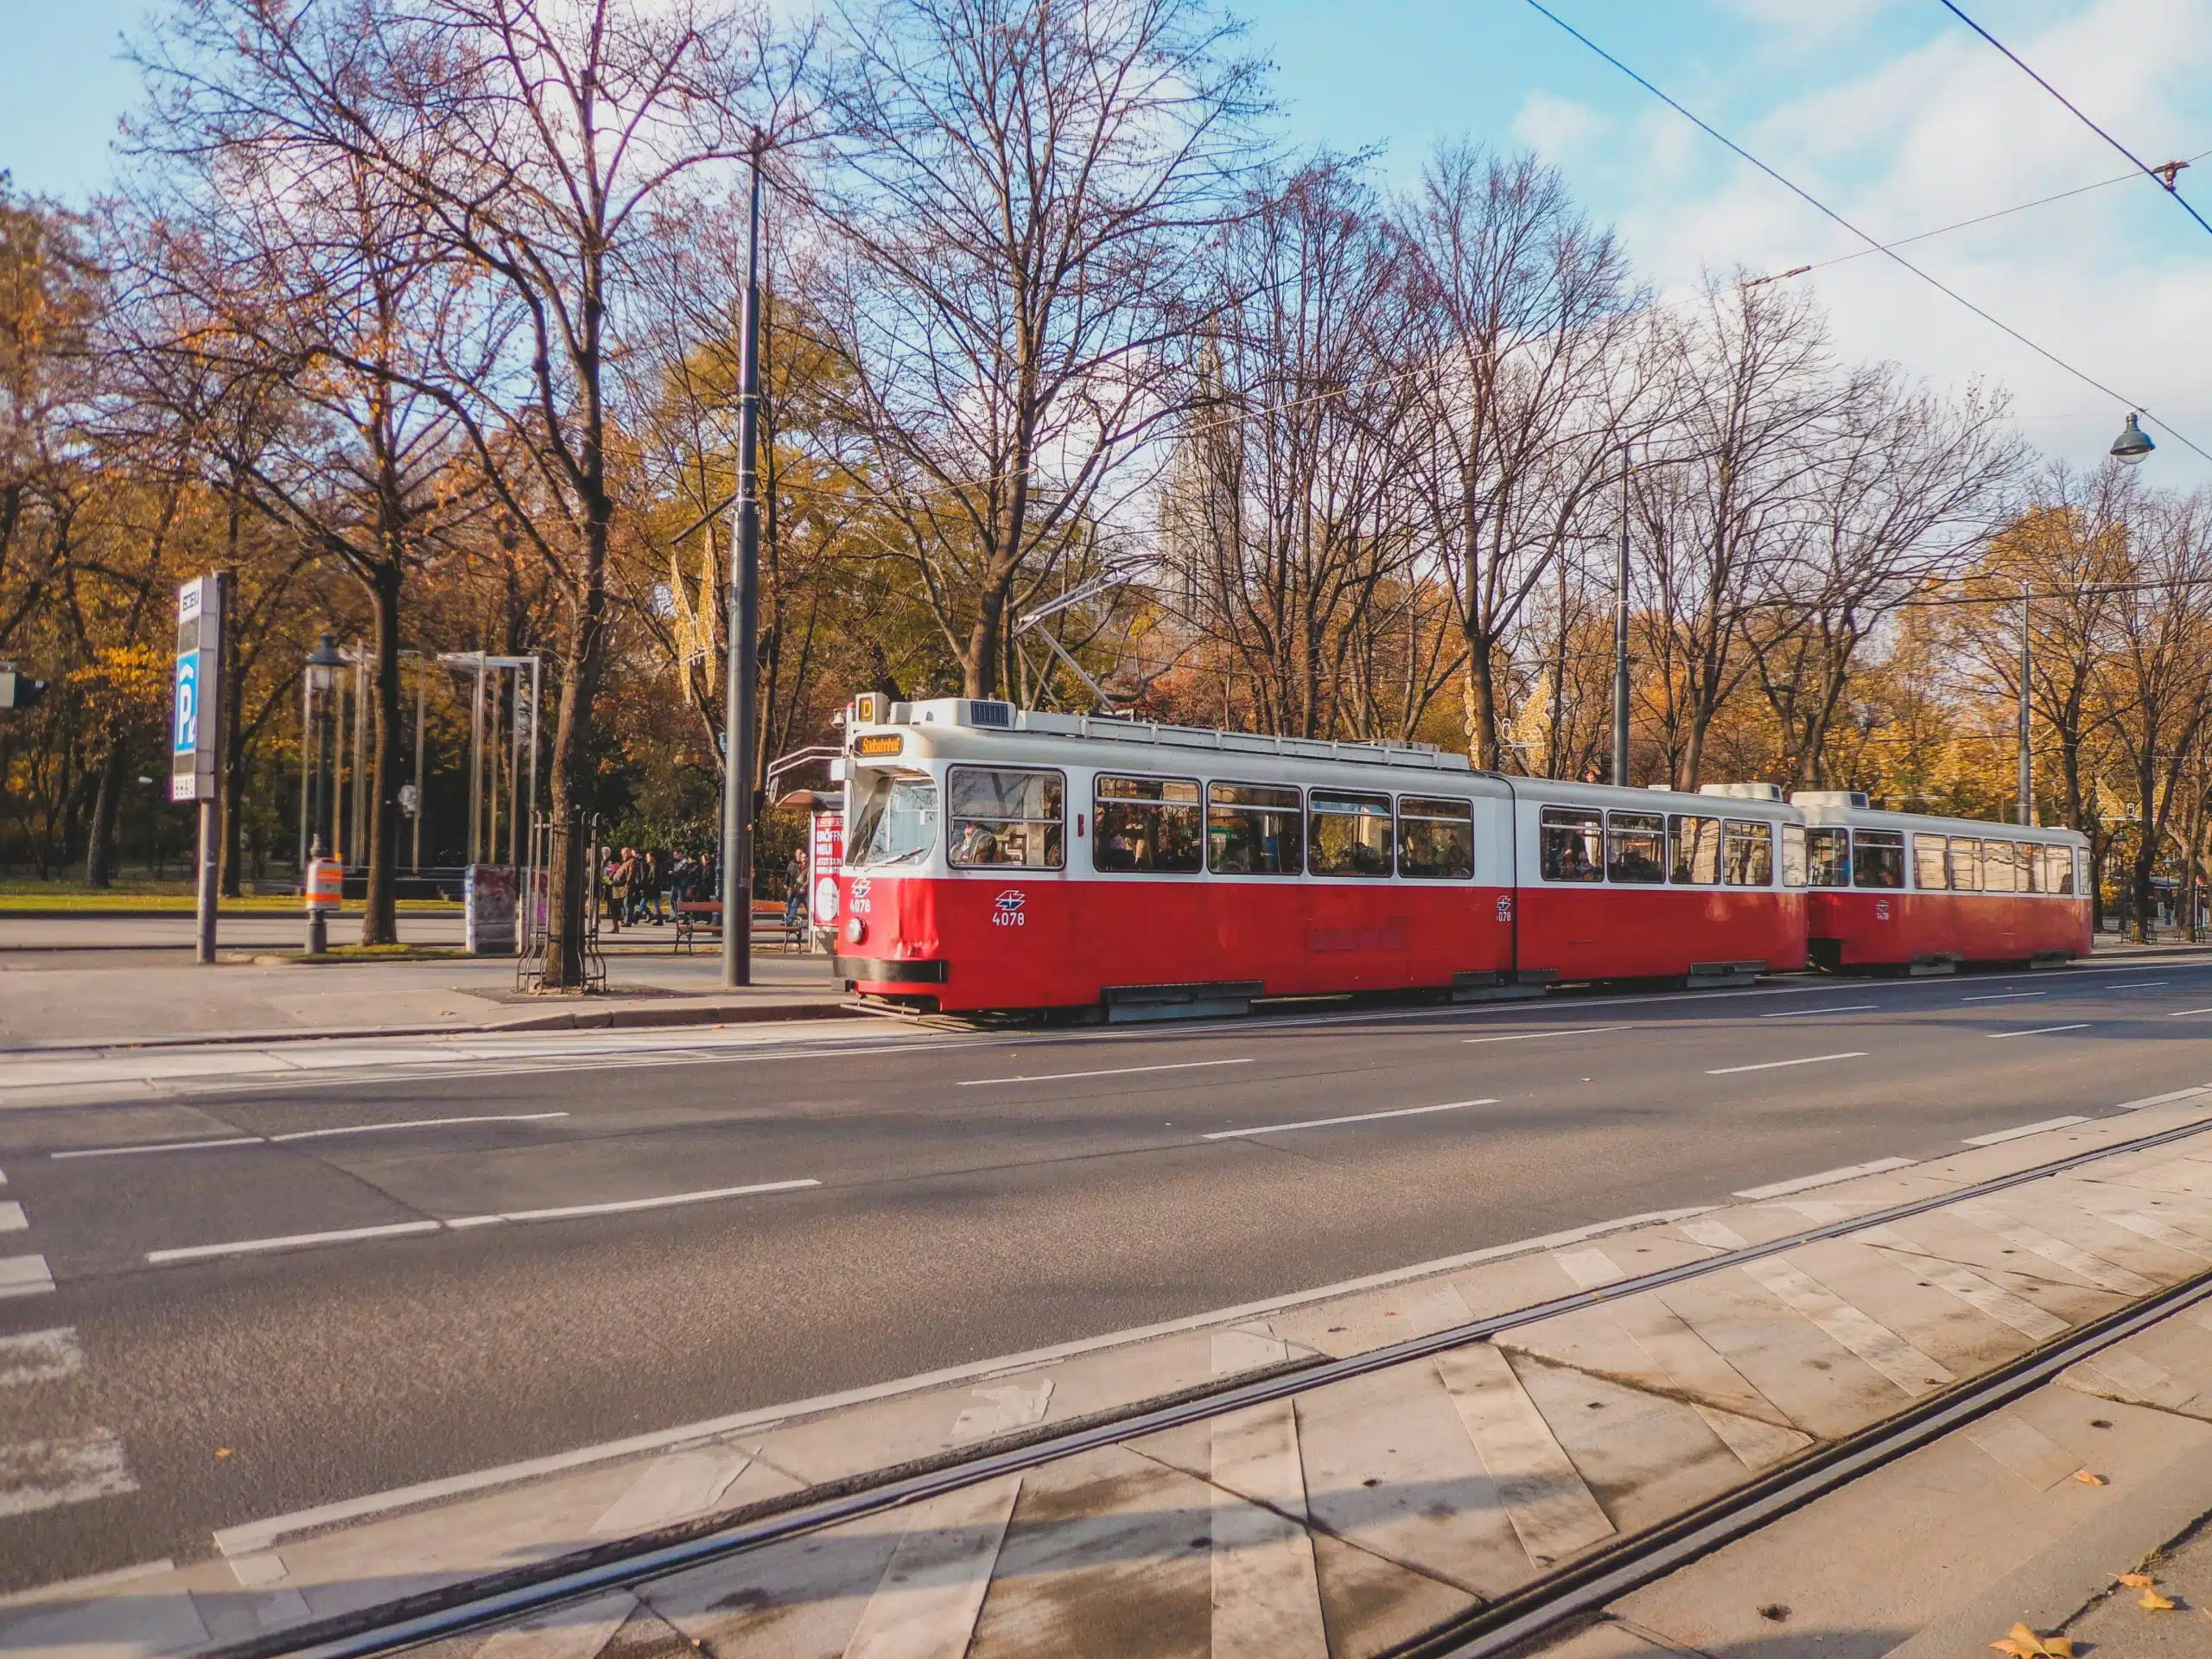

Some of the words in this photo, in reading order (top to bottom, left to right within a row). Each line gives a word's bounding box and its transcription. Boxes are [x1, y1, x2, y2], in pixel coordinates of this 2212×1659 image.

[863, 700, 872, 717] D
[862, 737, 900, 753] Südbahnhof
[850, 898, 871, 913] 4078
[992, 912, 1025, 926] 4078
[1496, 911, 1511, 922] 078
